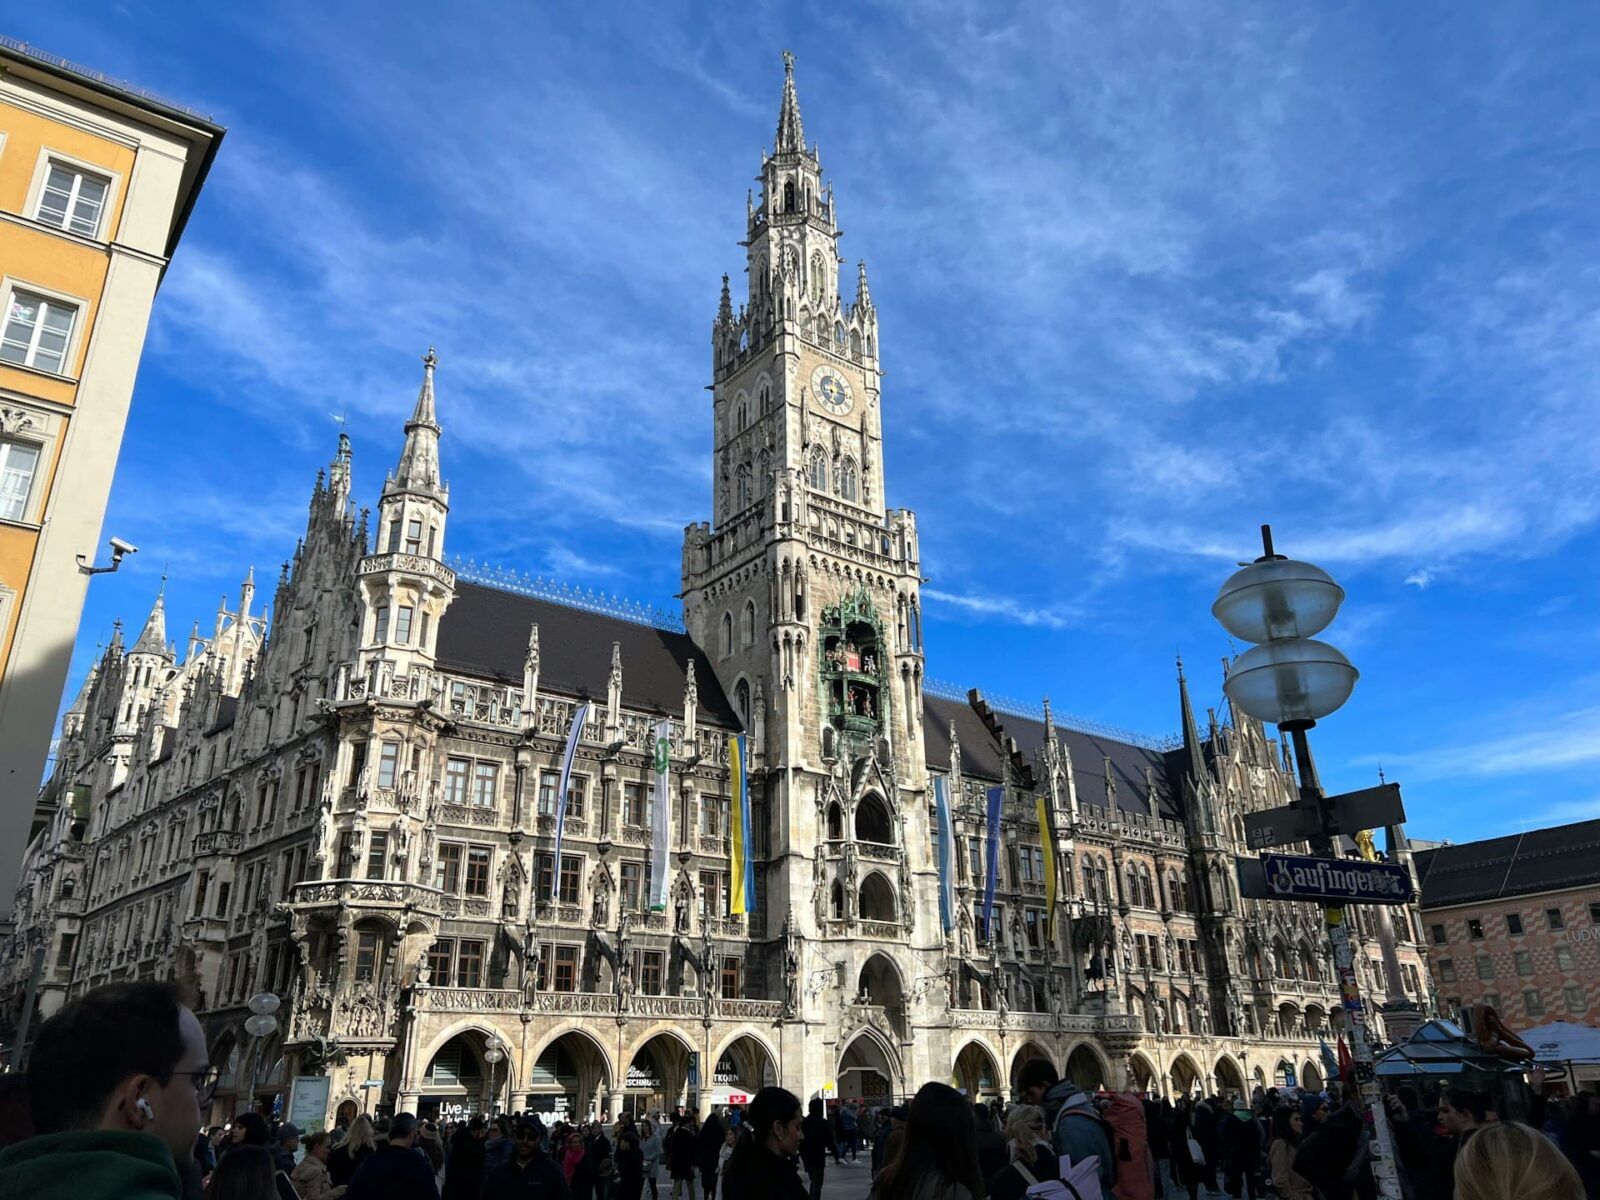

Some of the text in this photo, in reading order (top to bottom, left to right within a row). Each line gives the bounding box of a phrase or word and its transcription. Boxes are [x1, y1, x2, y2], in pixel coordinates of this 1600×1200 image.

[689, 1053, 696, 1066] S
[1285, 1064, 1293, 1074] S
[689, 1070, 696, 1083] U
[1287, 1075, 1295, 1086] U
[439, 1101, 463, 1115] Live
